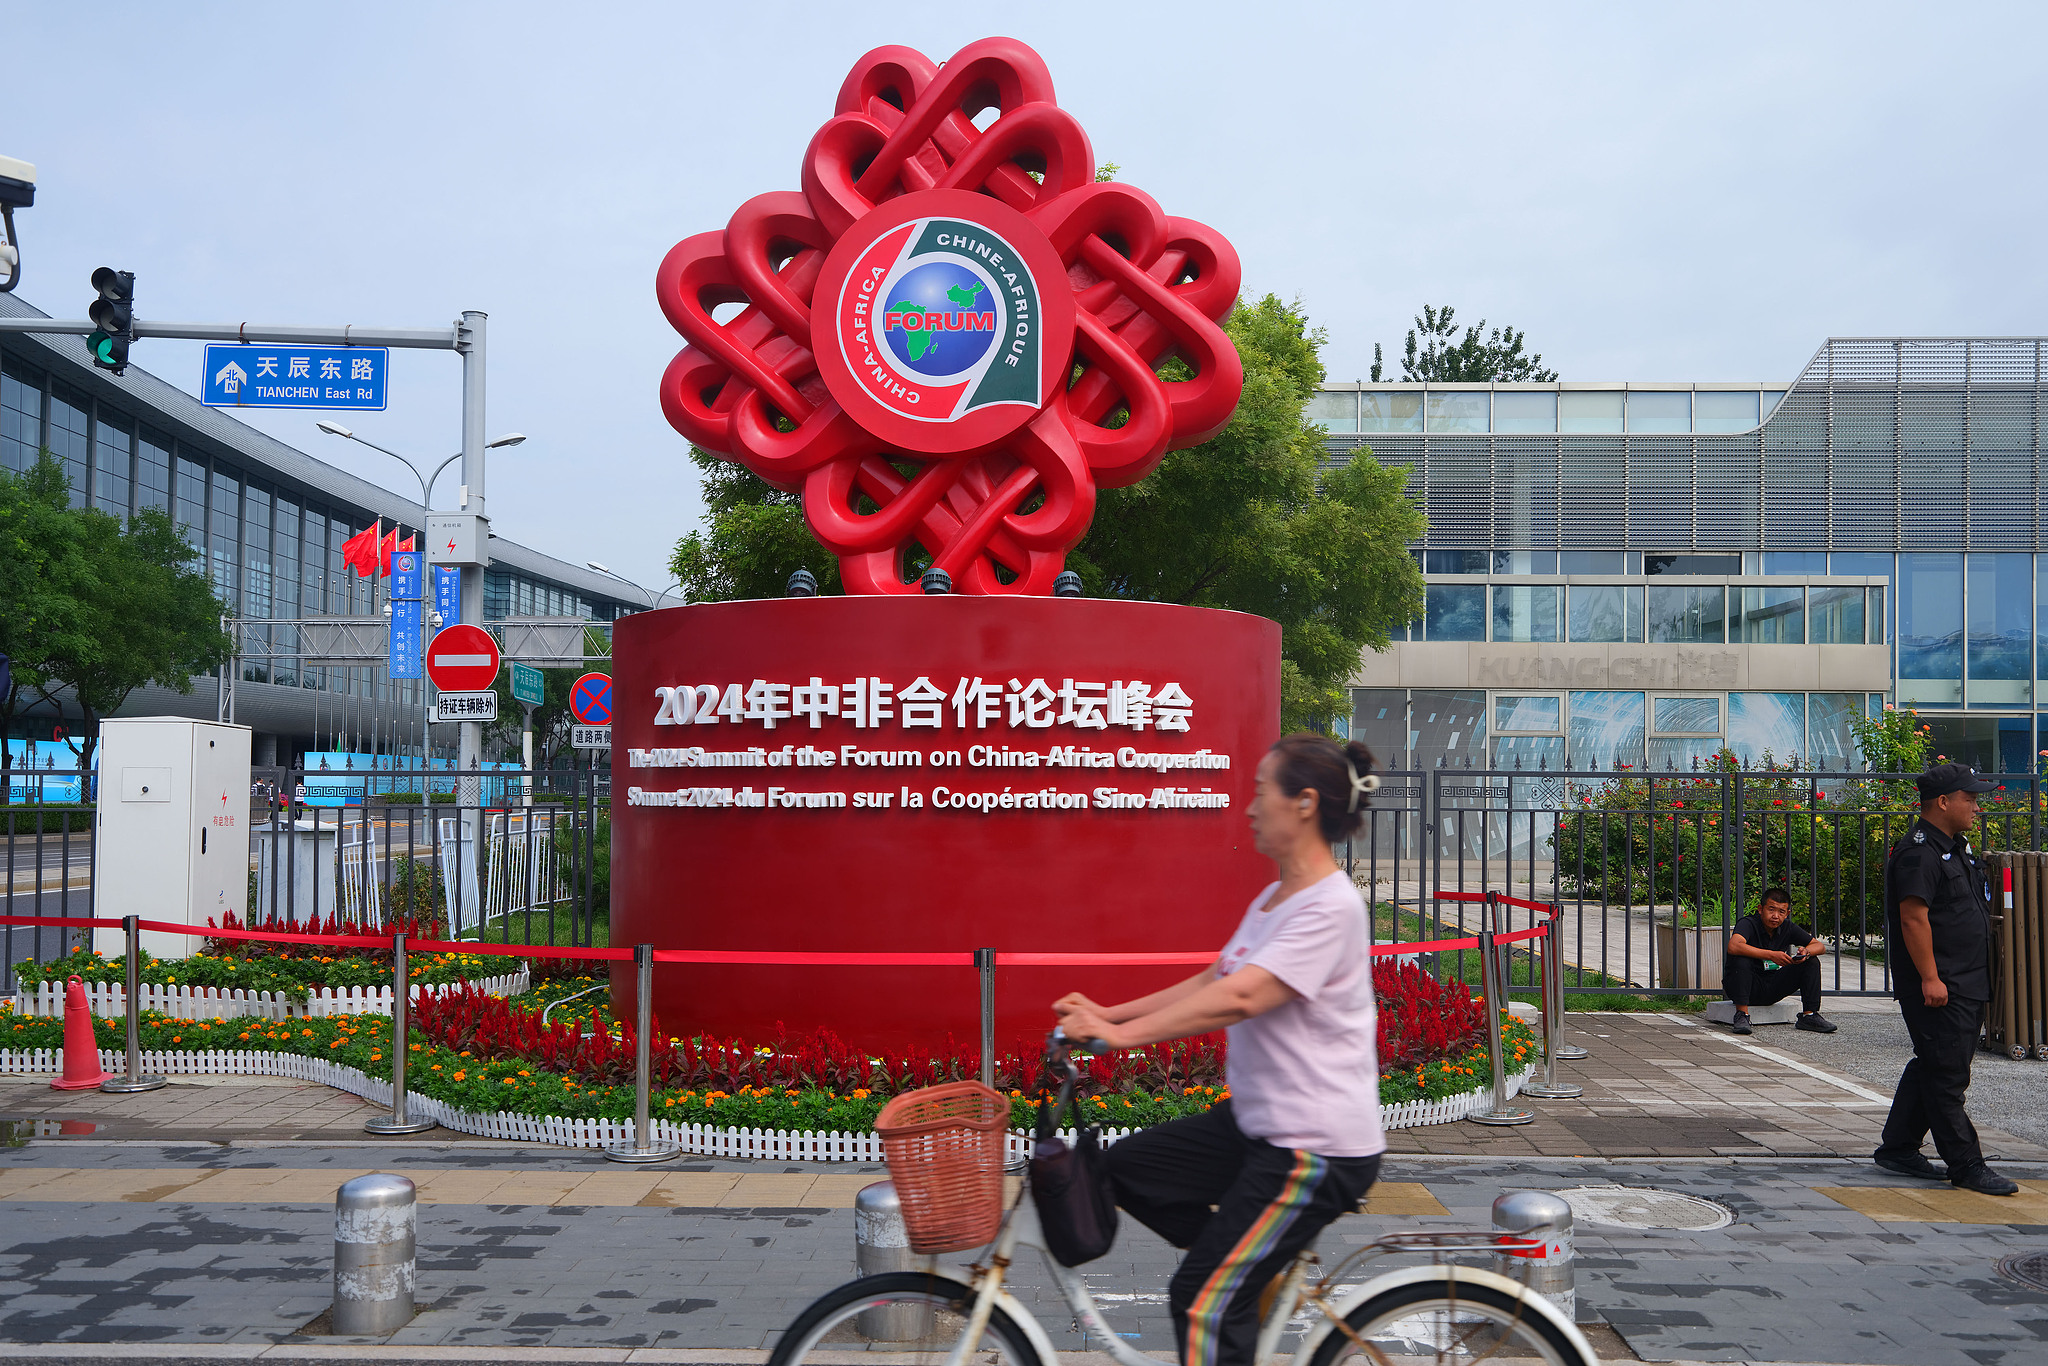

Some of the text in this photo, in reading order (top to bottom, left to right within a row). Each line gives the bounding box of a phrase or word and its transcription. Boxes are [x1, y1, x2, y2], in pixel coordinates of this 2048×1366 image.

[936, 233, 1028, 368] CHINE-AFRIQUE
[884, 311, 995, 332] FORUM
[855, 265, 921, 404] CHINA-AFRICA
[226, 369, 238, 381] 北
[256, 356, 374, 381] 天辰东路
[227, 382, 236, 391] N
[256, 386, 373, 400] TIANCHEN East Rd
[439, 697, 494, 715] 持证车辆除外
[653, 676, 1193, 733] 2024年中非合作论坛峰会
[627, 745, 1230, 773] The 2024 Summit of the Forum on China-Africa Cooperation
[687, 787, 734, 807] 2024
[734, 786, 765, 807] du
[767, 786, 846, 808] Forum
[852, 790, 894, 808] sur
[901, 786, 923, 807] la
[931, 786, 1088, 813] Coopération
[1092, 786, 1230, 810] Sino-Africaine
